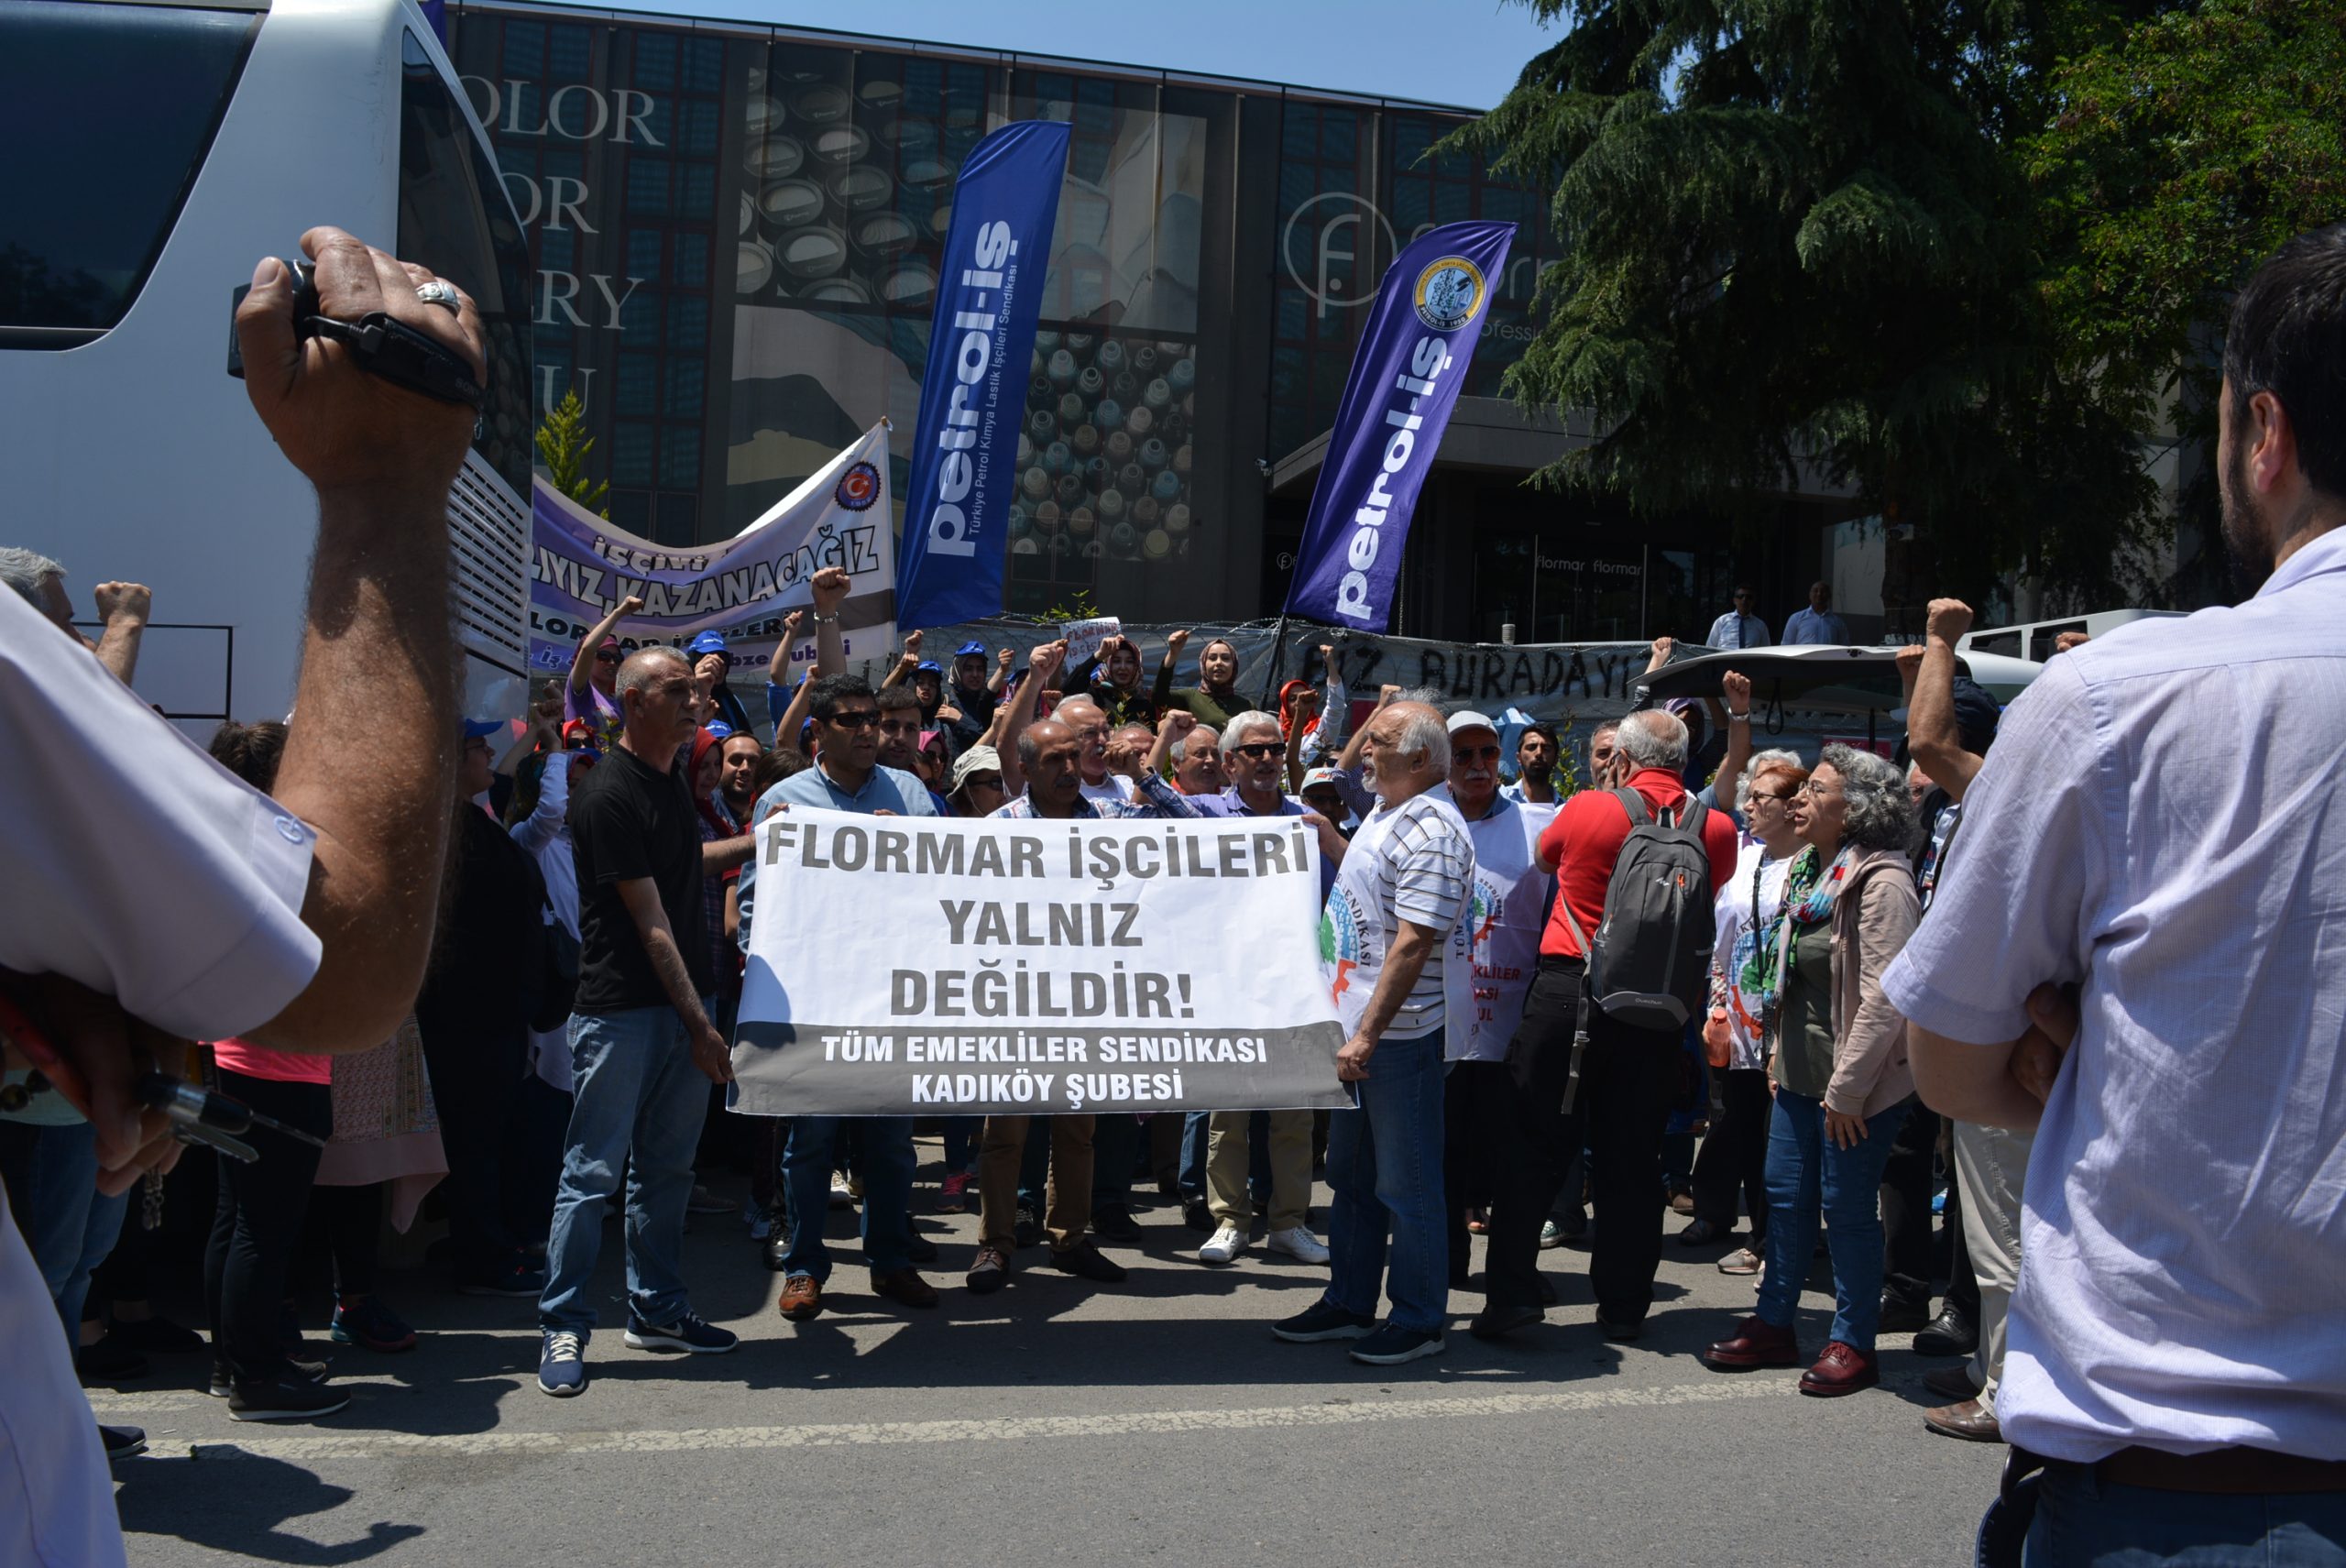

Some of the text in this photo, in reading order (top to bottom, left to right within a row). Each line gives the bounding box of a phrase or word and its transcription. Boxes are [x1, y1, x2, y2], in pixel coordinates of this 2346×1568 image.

[999, 264, 1018, 324] Sendikası
[1480, 320, 1541, 342] ofessi
[985, 370, 1001, 407] Lastik
[979, 411, 996, 450] Kimya
[974, 452, 990, 488] Petrol
[969, 492, 986, 535] Türkiye
[1594, 559, 1642, 576] flormar
[765, 822, 1309, 891] FLORMAR İŞCİLERİ
[938, 899, 1144, 948] YALNIZ
[890, 959, 1195, 1019] DEĞİLDİR!
[821, 1030, 1267, 1063] TÜM EMEKLİLER SENDİKASI
[911, 1068, 1183, 1110] KADIKÖY ŞUBESİ
